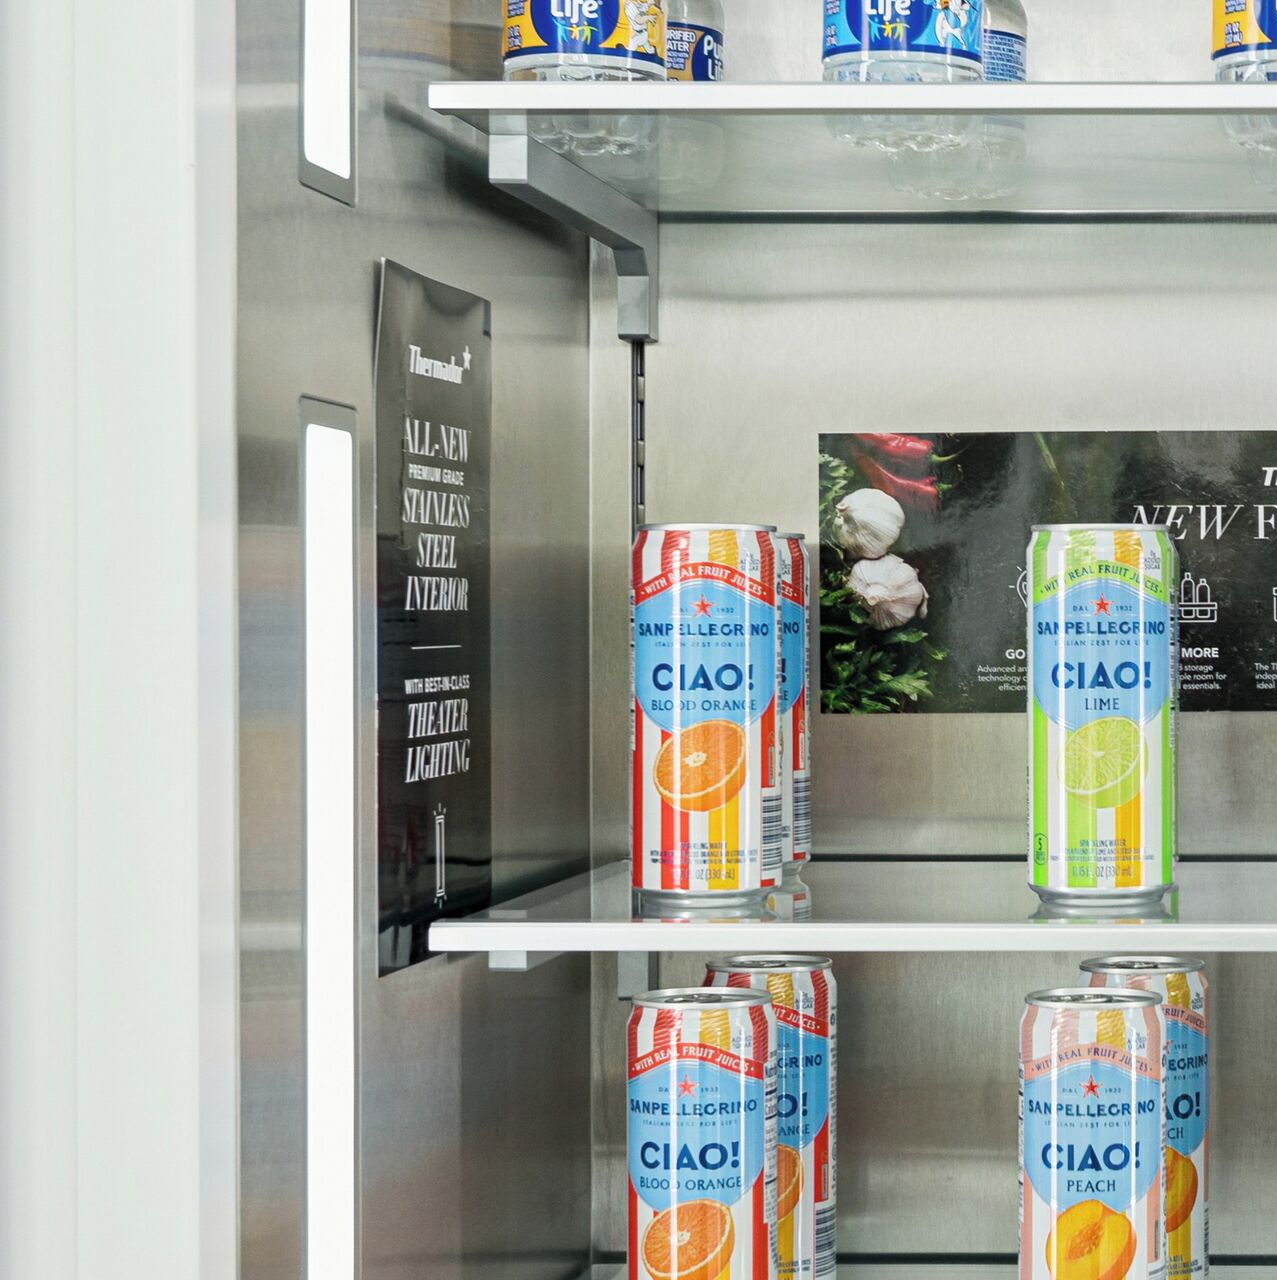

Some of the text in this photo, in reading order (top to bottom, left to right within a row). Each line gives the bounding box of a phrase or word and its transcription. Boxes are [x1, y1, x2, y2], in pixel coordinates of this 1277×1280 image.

[408, 343, 464, 385] Thermador
[403, 417, 472, 463] ALL-NEW
[408, 463, 465, 486] PREMIUM GRADE
[401, 487, 471, 529] STAINLESS
[416, 532, 458, 569] STEEL
[644, 566, 731, 594] WITH FRUIT
[1068, 563, 1129, 581] REAL FRUIT
[404, 575, 469, 612] INTERIOR
[1114, 639, 1131, 647] FOR
[1181, 647, 1220, 658] MORE
[976, 665, 1016, 673] Advanced
[1051, 661, 1152, 690] CIAO!
[1184, 663, 1214, 674] storage
[1193, 671, 1228, 681] room for
[1254, 662, 1270, 671] The
[404, 674, 471, 695] WITH BEST-IN-CLASS
[652, 662, 754, 692] CIAO!
[978, 674, 1021, 684] technology
[1182, 681, 1222, 691] essentials.
[1256, 681, 1276, 689] ideal
[1085, 697, 1120, 711] LIME
[407, 697, 469, 739] THEATER
[404, 738, 471, 784] LIGHTING
[634, 1054, 654, 1071] WITH
[682, 1046, 715, 1059] FRUIT
[1058, 1047, 1118, 1062] REAL FRUIT
[1028, 1098, 1156, 1118] SANPELLEGRNO
[640, 1141, 740, 1170] CIAO!
[1041, 1141, 1141, 1172] CIAO!
[685, 1176, 742, 1191] ORANGE
[1067, 1179, 1116, 1193] PEACH
